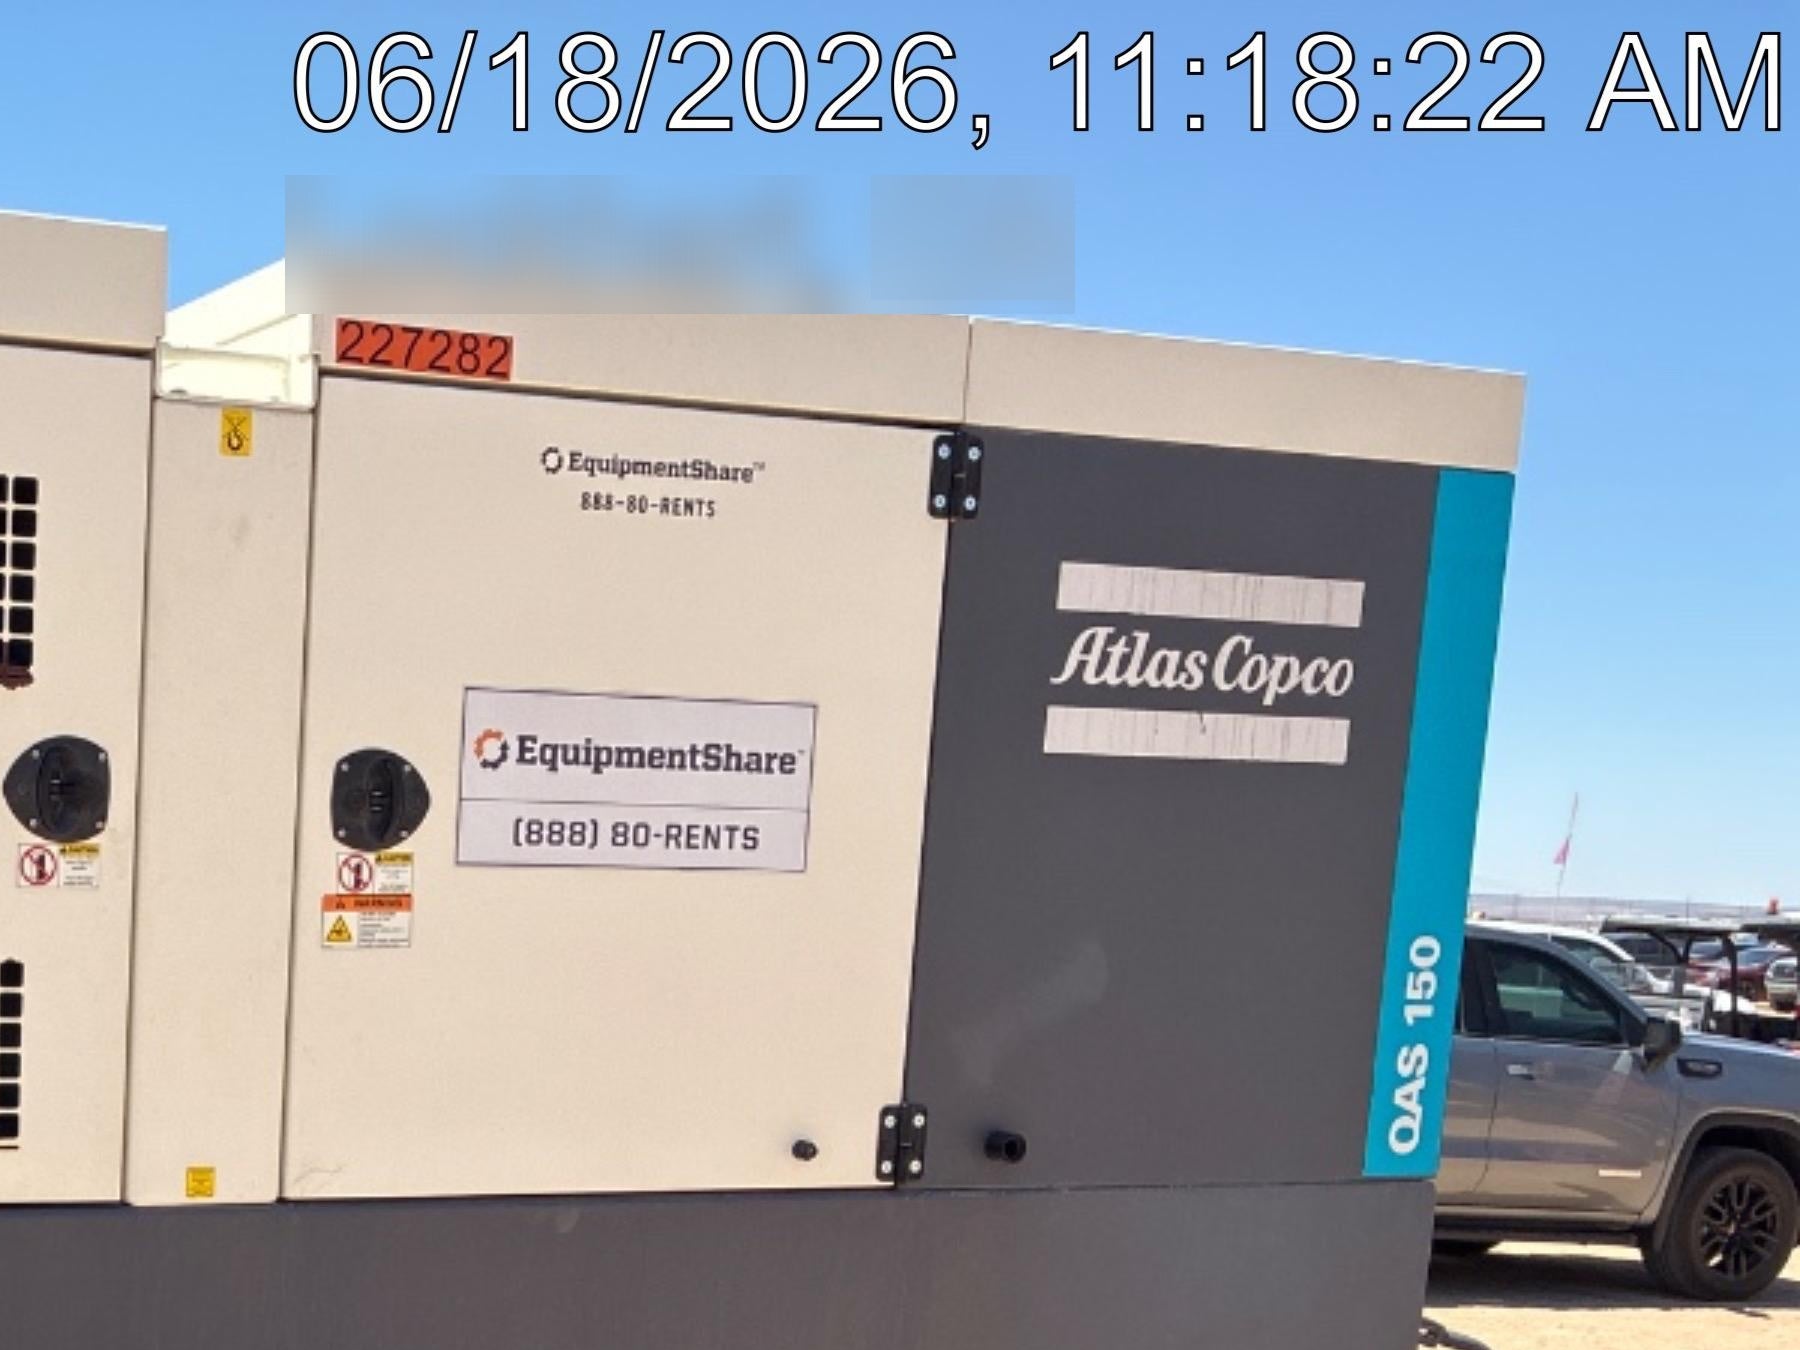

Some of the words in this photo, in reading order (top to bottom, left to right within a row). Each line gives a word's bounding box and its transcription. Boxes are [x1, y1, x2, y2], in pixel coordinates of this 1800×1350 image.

[338, 320, 510, 378] 227282
[580, 491, 716, 518] 888-80-RENTS
[1050, 626, 1207, 690] Atlas
[1212, 634, 1354, 705] Copco
[512, 817, 598, 849] (888)
[610, 821, 760, 850] 80-RENTS
[1403, 935, 1441, 1026] 150
[1388, 1043, 1430, 1155] QAS
